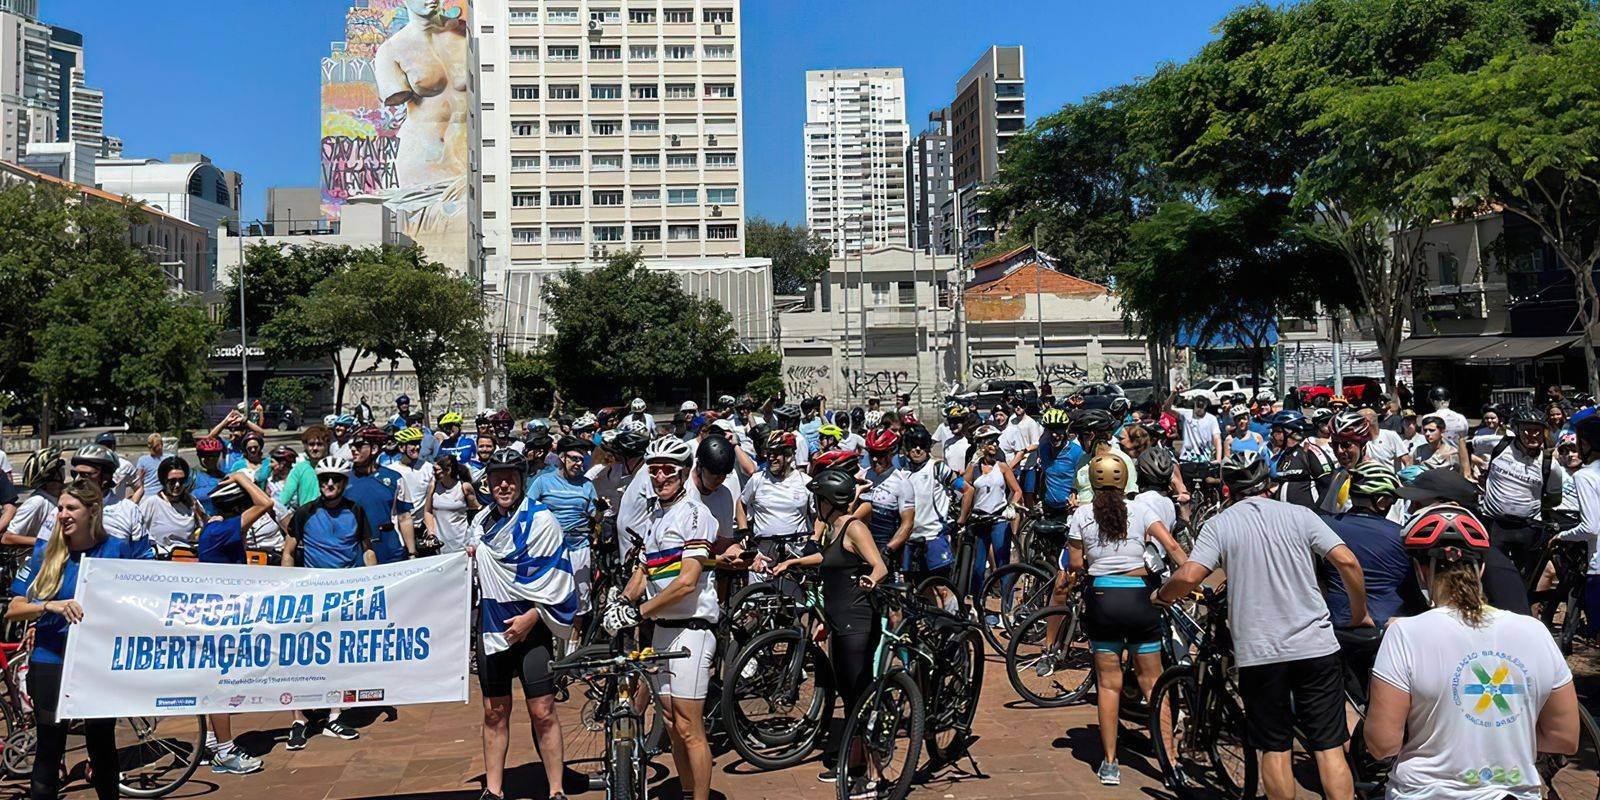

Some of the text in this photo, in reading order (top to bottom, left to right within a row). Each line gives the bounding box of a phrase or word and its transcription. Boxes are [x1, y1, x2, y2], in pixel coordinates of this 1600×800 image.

[111, 622, 430, 675] LIBERTAÇÃO DOS REFÉNS
